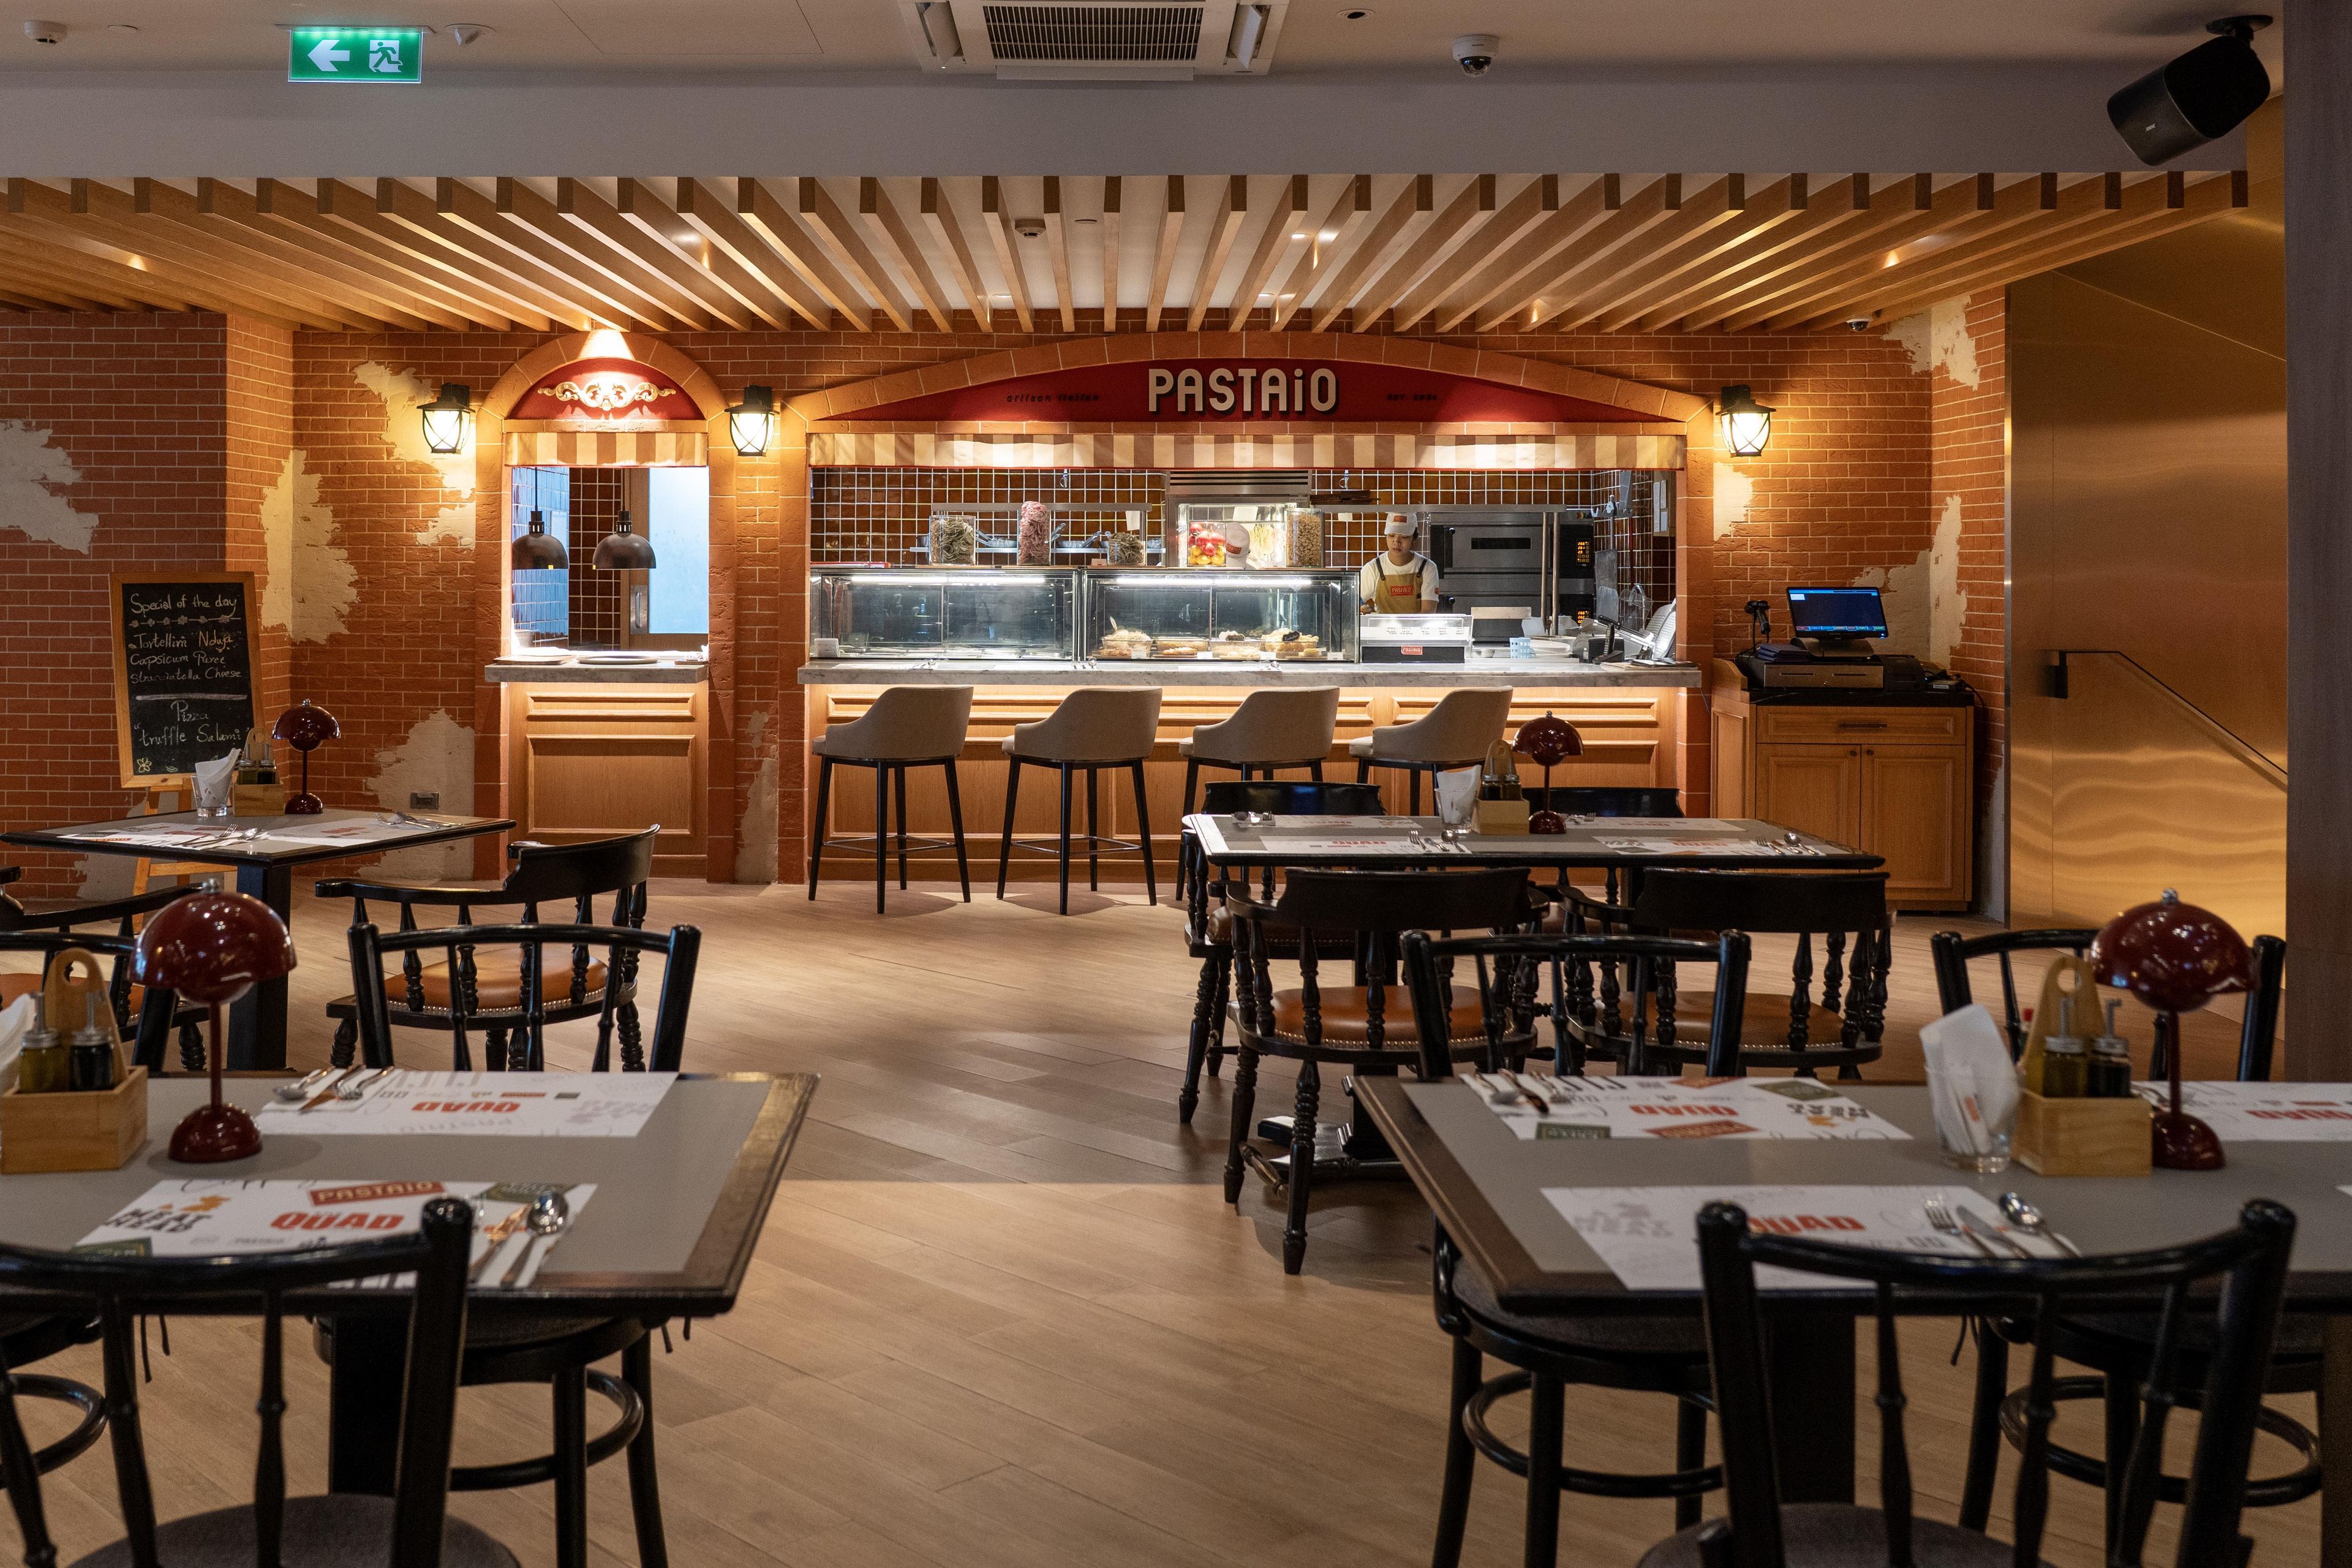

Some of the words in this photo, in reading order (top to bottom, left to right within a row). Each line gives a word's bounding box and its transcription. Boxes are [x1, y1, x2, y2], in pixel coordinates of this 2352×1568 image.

[1007, 393, 1051, 402] artisan
[130, 593, 172, 617] Special
[177, 594, 187, 608] of
[192, 594, 211, 608] the
[215, 594, 237, 618] day
[130, 654, 189, 669] Capsicum
[270, 1212, 405, 1231] QUAD
